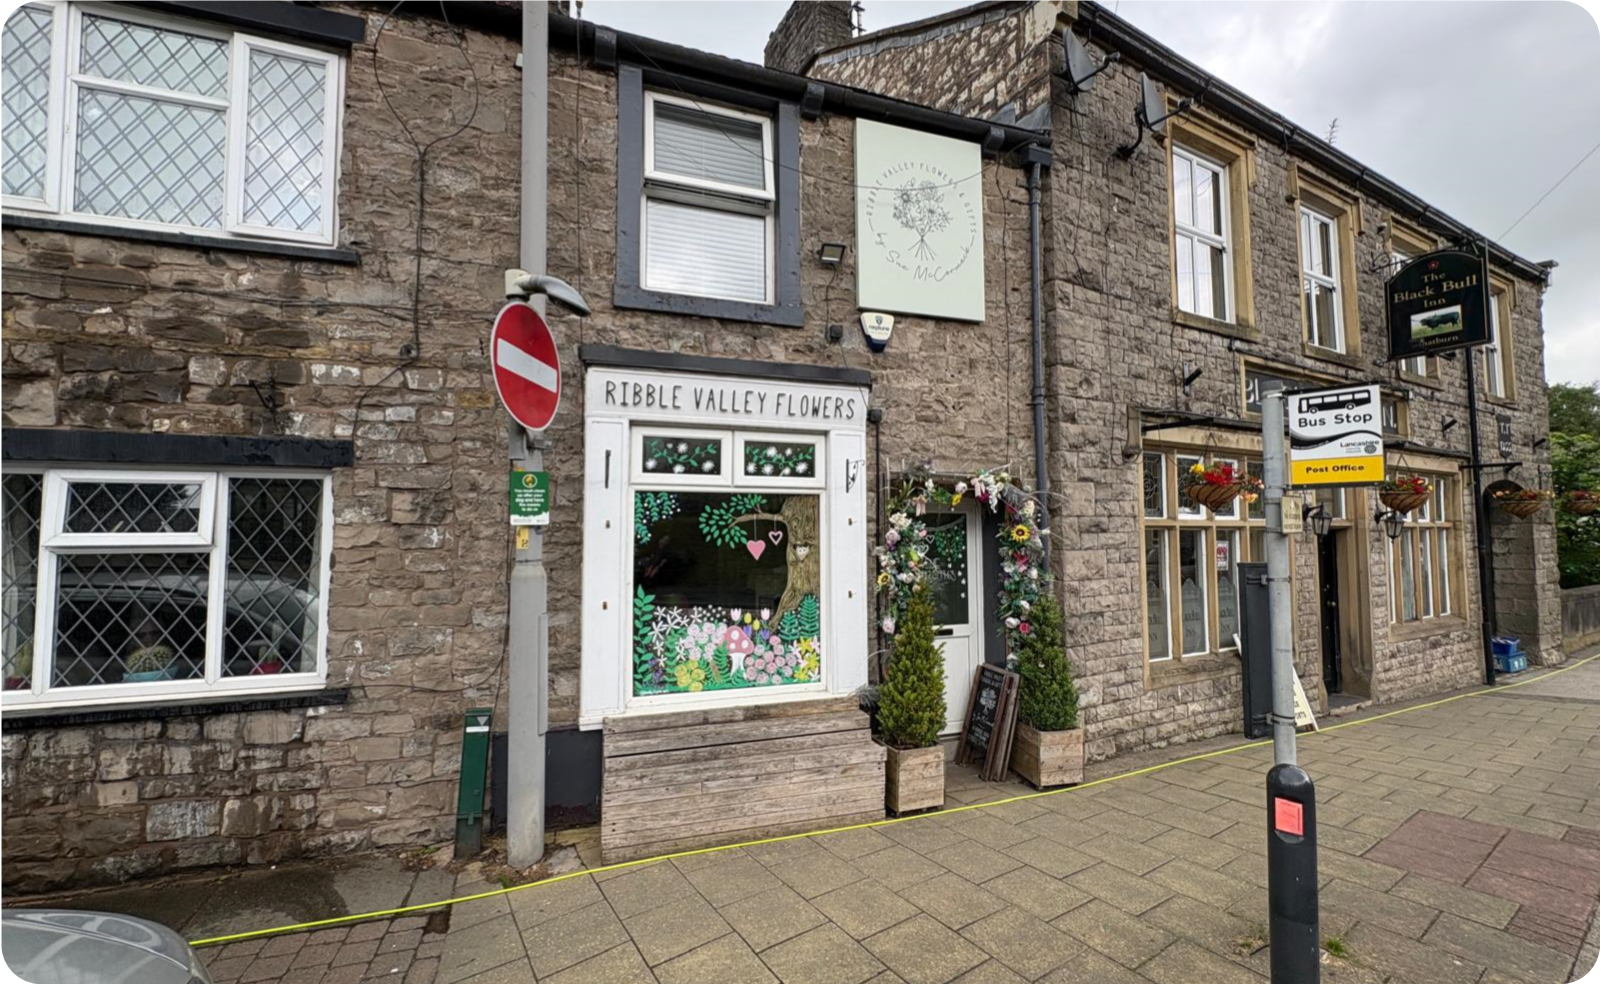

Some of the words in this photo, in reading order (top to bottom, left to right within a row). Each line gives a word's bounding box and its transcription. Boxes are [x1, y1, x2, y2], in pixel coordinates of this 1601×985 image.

[881, 161, 915, 180] VALLEY
[919, 162, 958, 190] FLOWERS
[963, 201, 977, 234] GIFTS
[885, 250, 910, 271] Sue
[1421, 272, 1446, 283] The
[1393, 285, 1436, 304] Black
[1442, 274, 1479, 293] Bull
[1423, 297, 1447, 309] Inn
[605, 380, 683, 409] RIBBLE
[693, 386, 768, 415] VALLEY
[775, 391, 856, 420] FLOWERS
[1298, 416, 1327, 428] Bus
[1333, 412, 1373, 424] Stop
[1339, 439, 1380, 448] Lancashire
[1305, 466, 1329, 474] Post
[1332, 464, 1365, 472] Office
